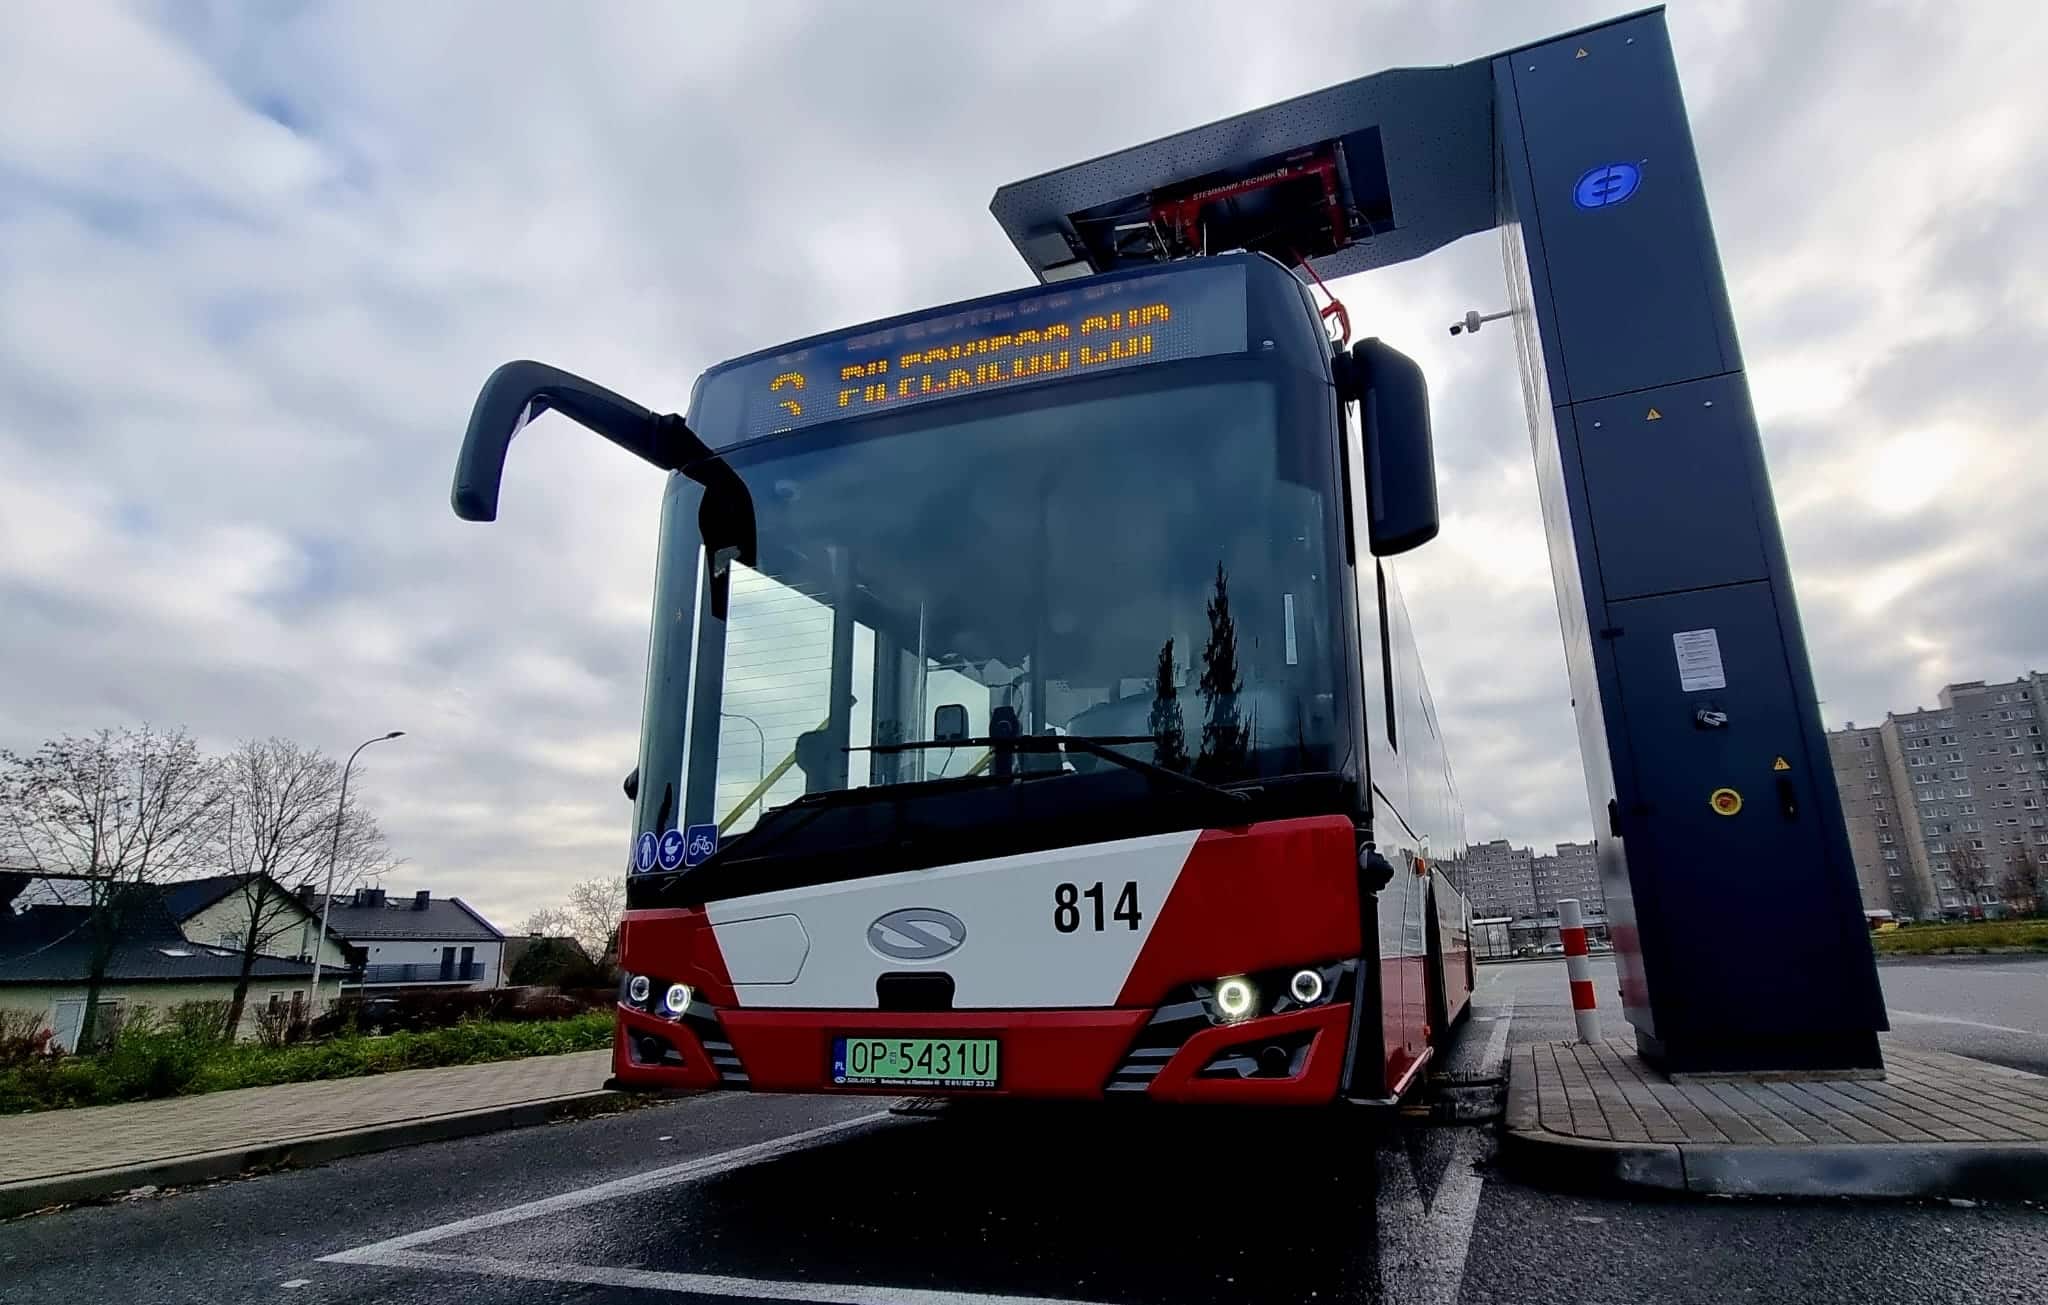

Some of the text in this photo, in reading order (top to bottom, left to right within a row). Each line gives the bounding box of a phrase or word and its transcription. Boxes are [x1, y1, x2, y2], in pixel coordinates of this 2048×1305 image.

[1054, 881, 1142, 933] 814
[852, 1041, 887, 1074] OP
[899, 1042, 990, 1076] 5431U
